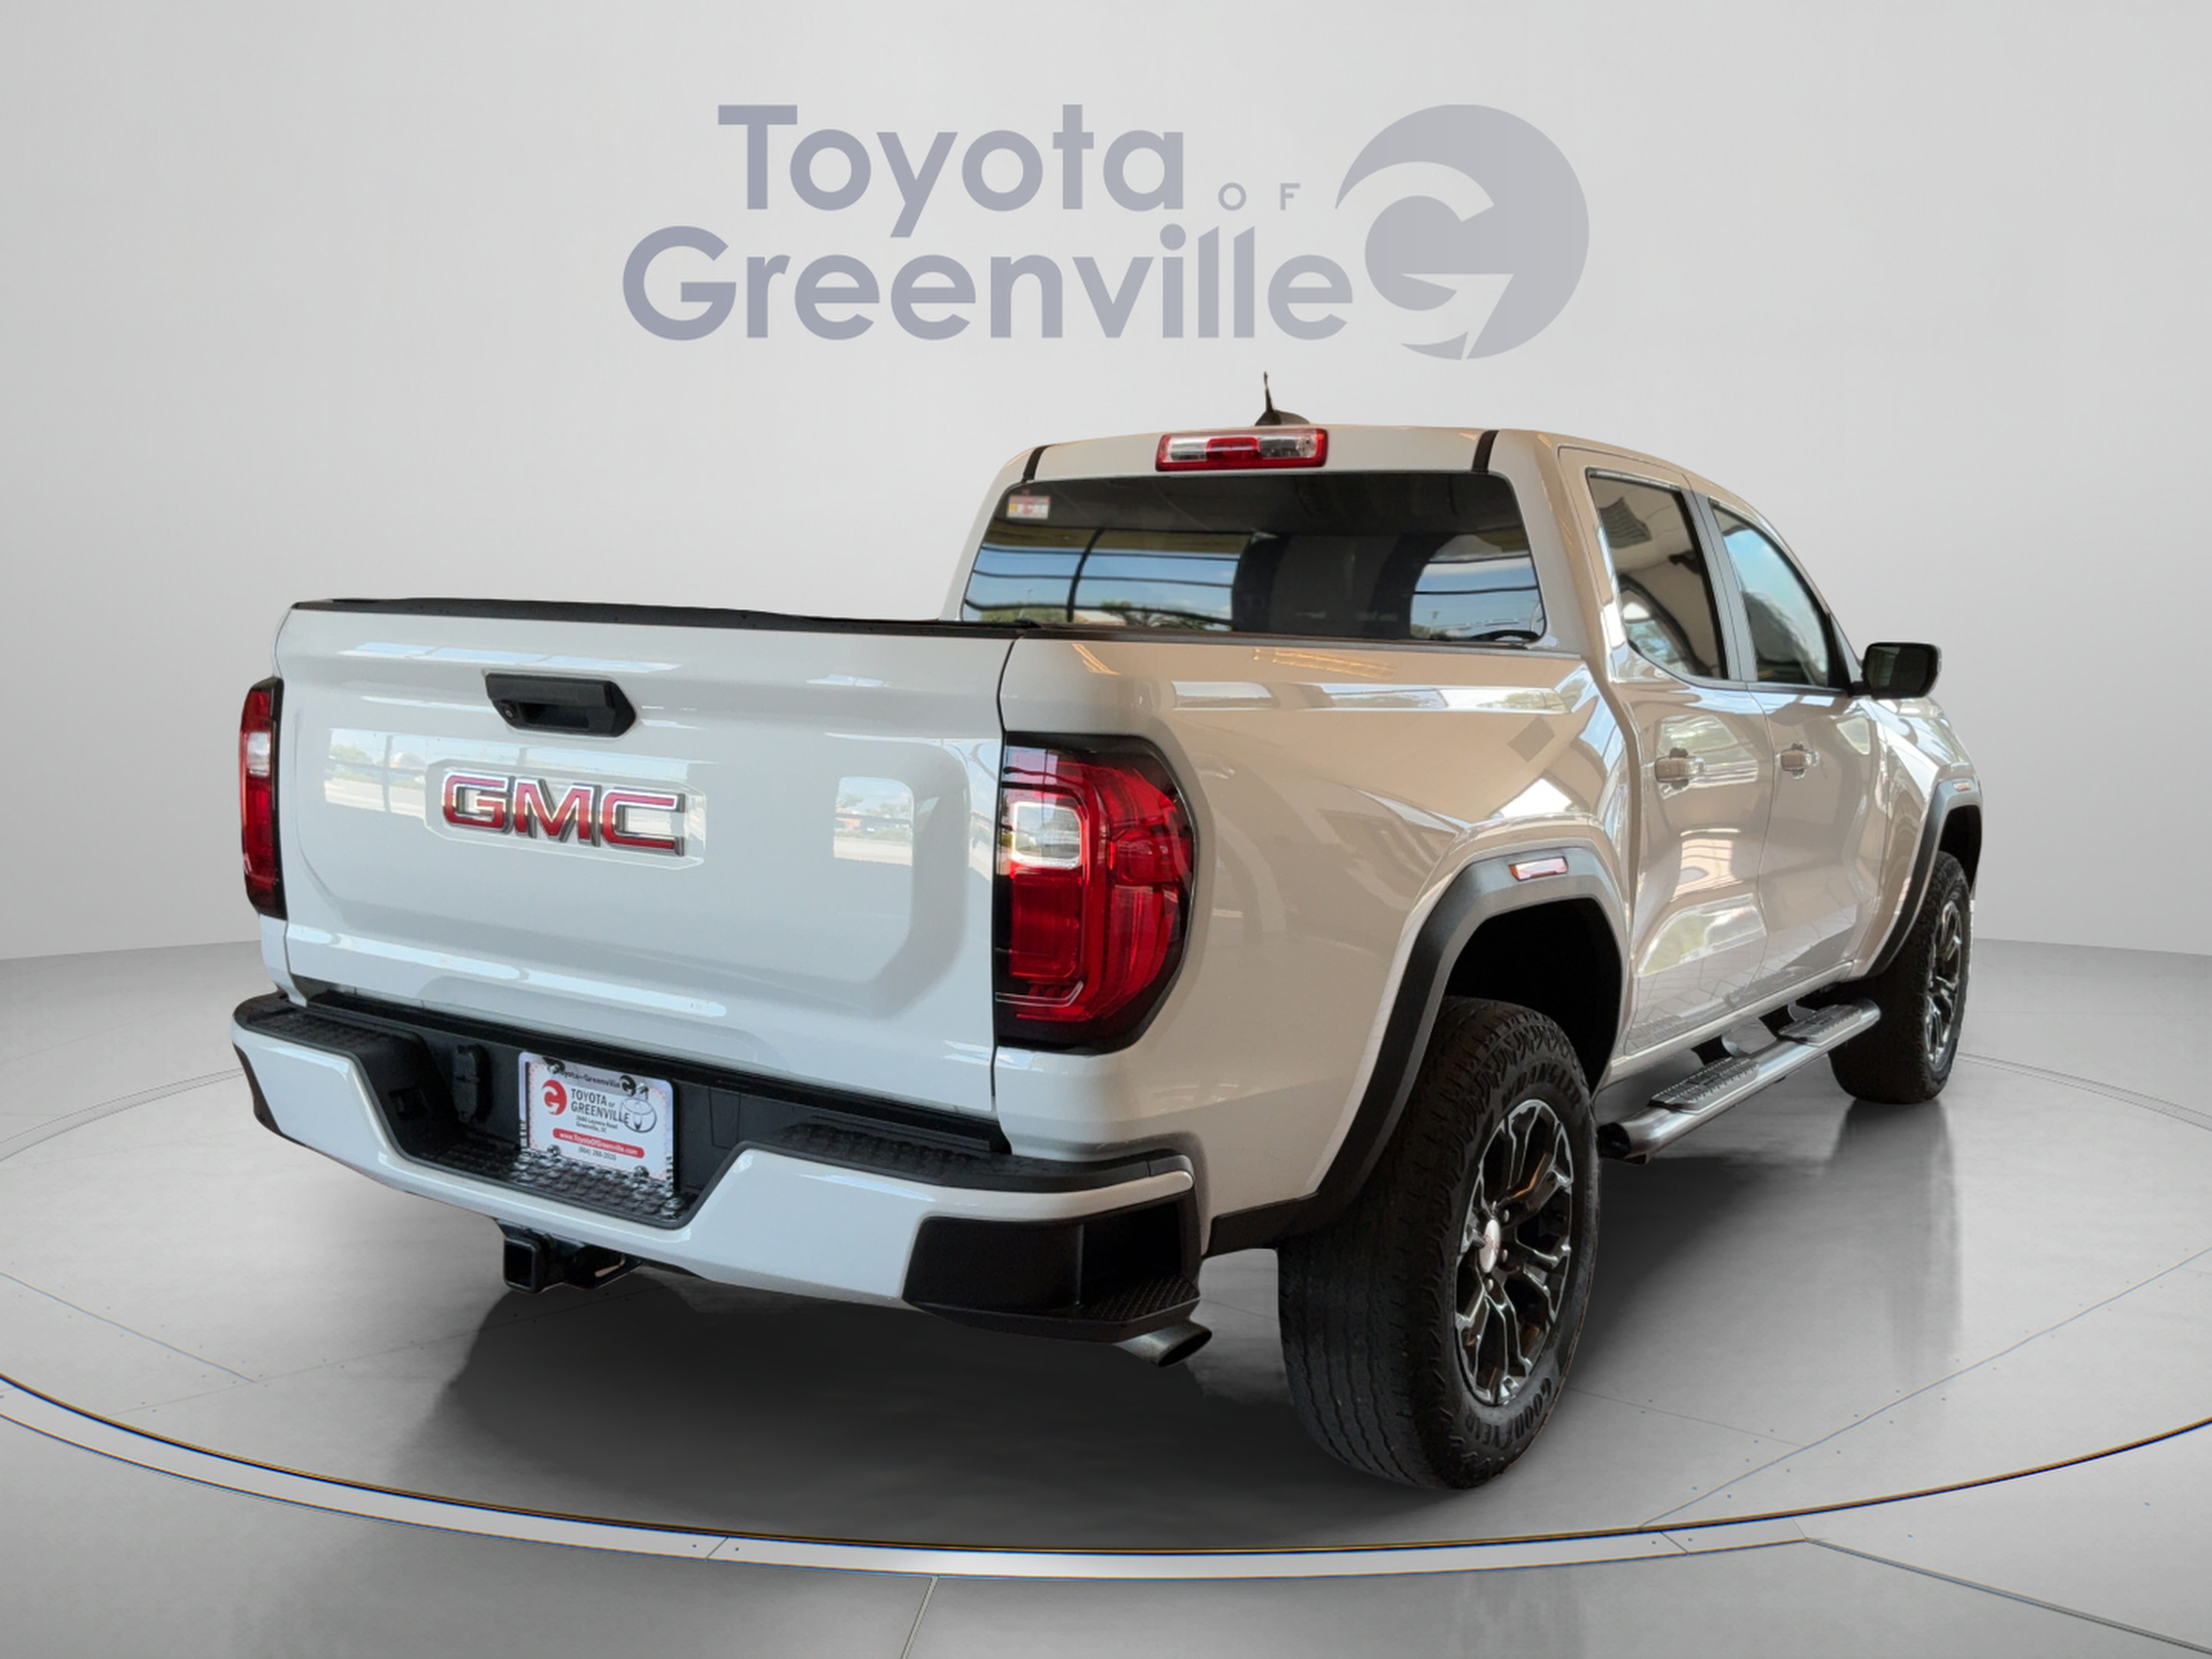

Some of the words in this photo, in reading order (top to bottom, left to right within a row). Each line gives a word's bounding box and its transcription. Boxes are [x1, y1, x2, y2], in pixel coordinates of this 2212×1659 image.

[442, 770, 685, 856] GMC
[571, 1088, 608, 1107] TOYOTA
[571, 1101, 631, 1124] GREENVILLE
[1465, 1377, 1552, 1449] GOODYEAR
